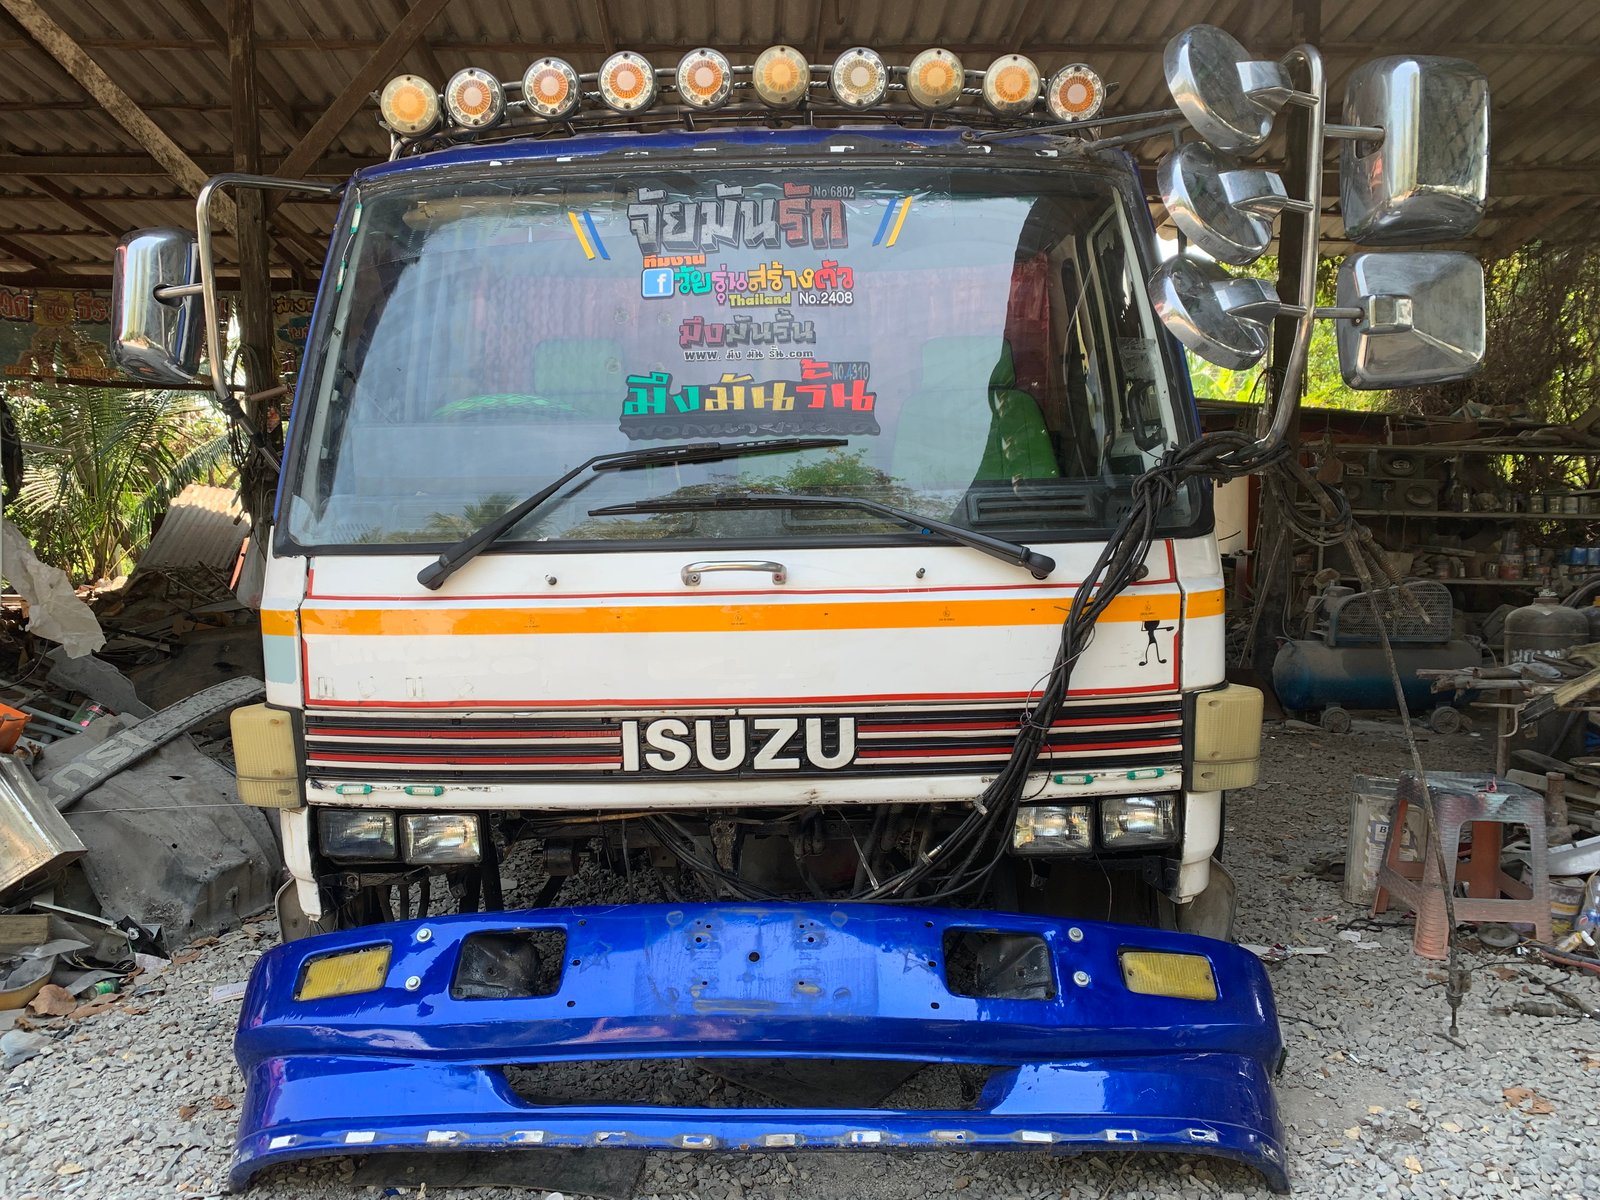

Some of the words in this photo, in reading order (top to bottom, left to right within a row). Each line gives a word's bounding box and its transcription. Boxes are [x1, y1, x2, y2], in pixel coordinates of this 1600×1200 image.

[830, 185, 856, 198] 6802
[643, 254, 705, 268] ทีมงาน
[674, 260, 855, 305] วัยรุ่นสร้างตัว
[728, 293, 791, 307] Thailand
[799, 291, 854, 305] No.2408
[679, 308, 816, 349] มึงมันรั้น
[622, 717, 855, 772] ISUZU
